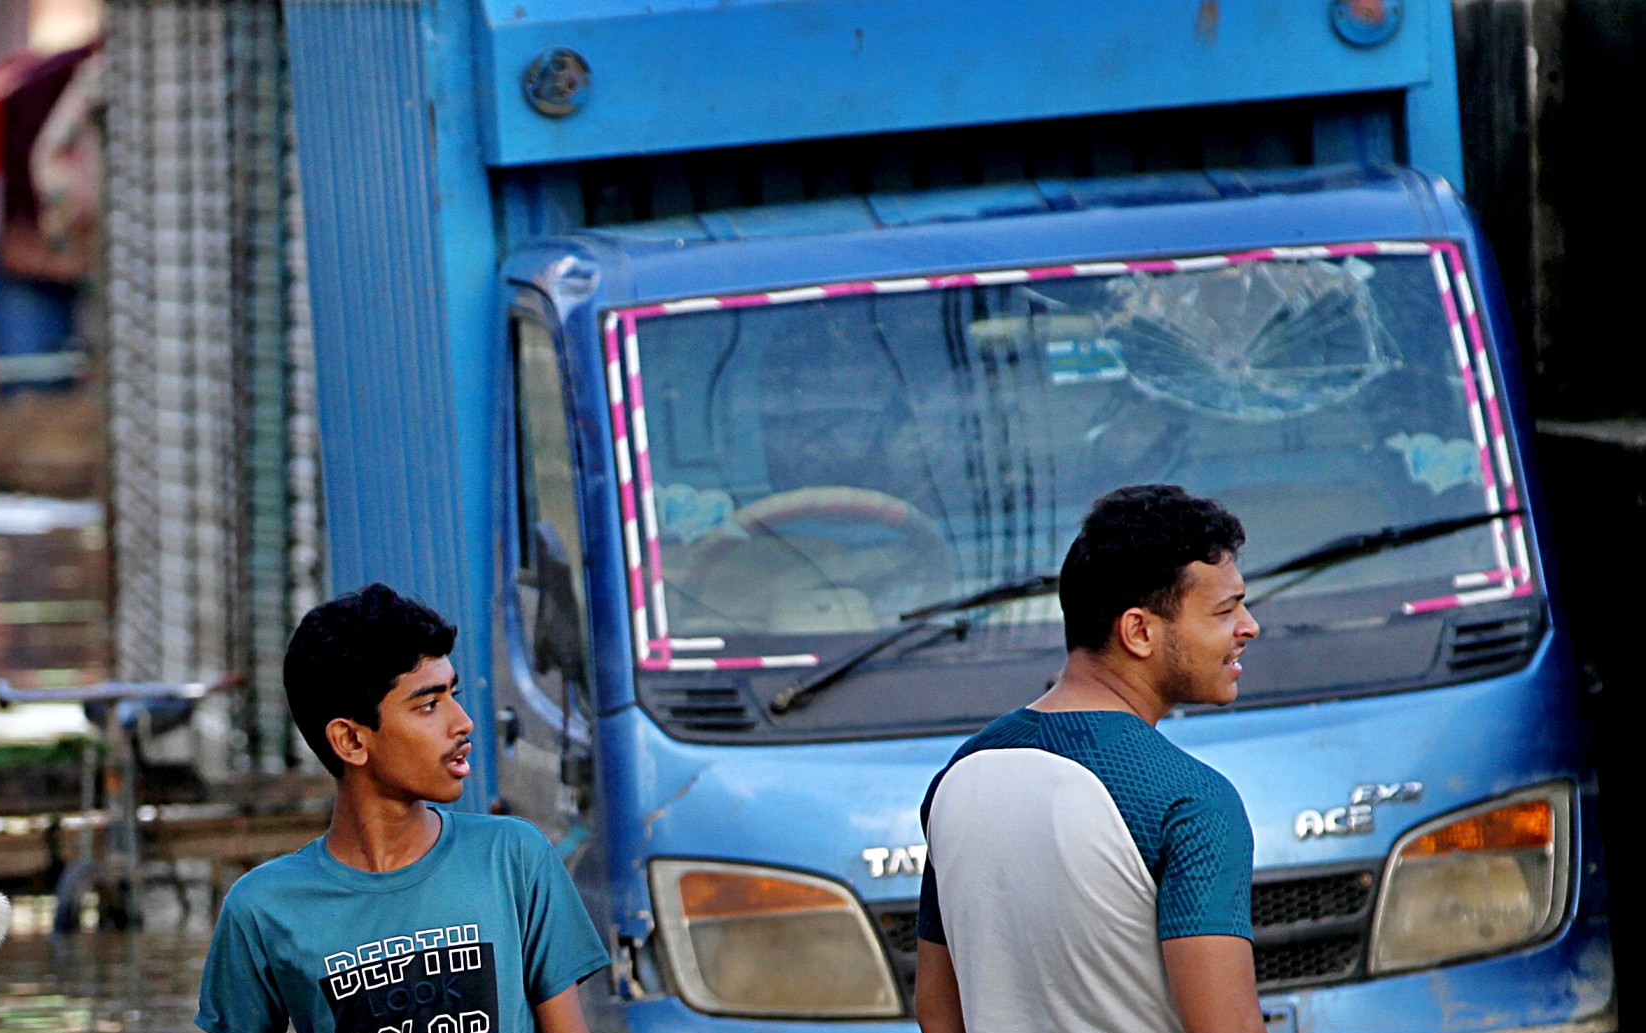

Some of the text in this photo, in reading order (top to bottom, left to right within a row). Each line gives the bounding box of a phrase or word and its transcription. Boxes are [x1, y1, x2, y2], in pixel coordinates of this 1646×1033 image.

[1294, 804, 1374, 840] ACE
[324, 923, 482, 1000] DEPTH
[367, 976, 463, 1017] LOOK
